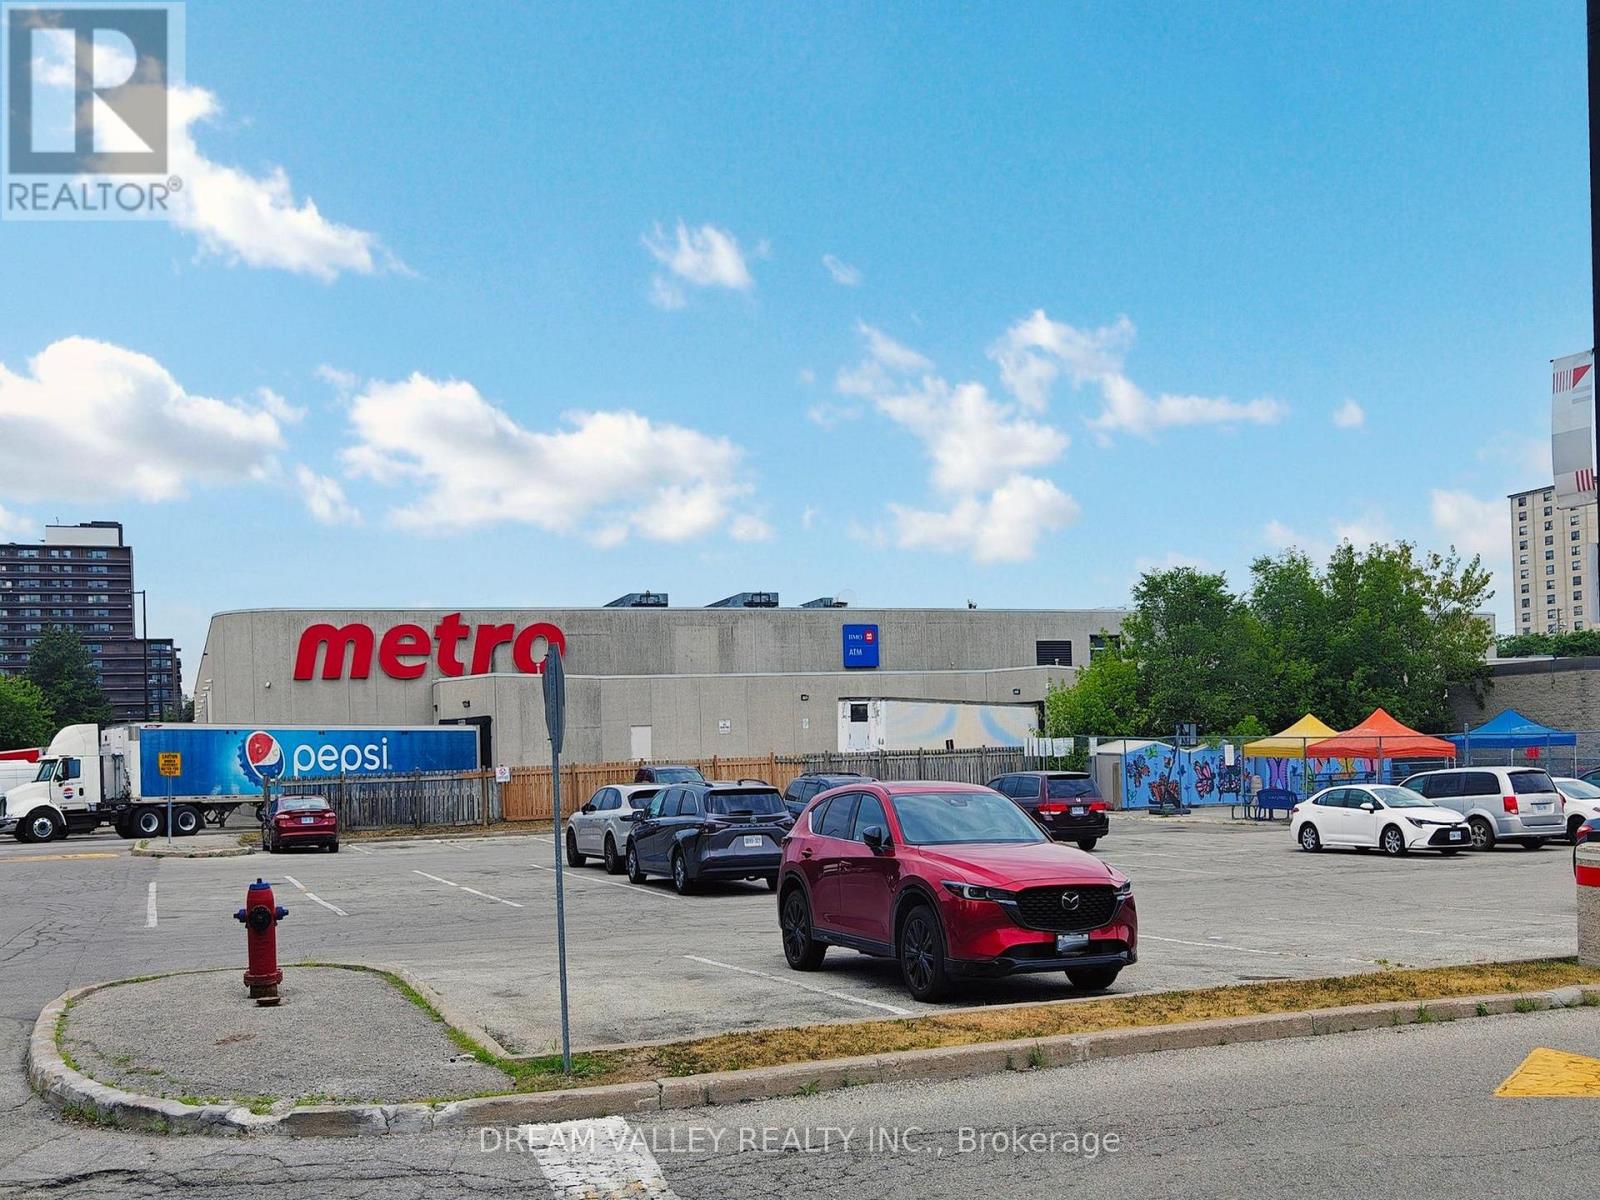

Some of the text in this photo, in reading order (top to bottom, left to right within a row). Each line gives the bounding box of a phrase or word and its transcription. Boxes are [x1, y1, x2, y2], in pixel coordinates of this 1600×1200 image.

[293, 612, 566, 681] metro
[848, 648, 863, 656] ATM
[293, 736, 389, 780] pepsi
